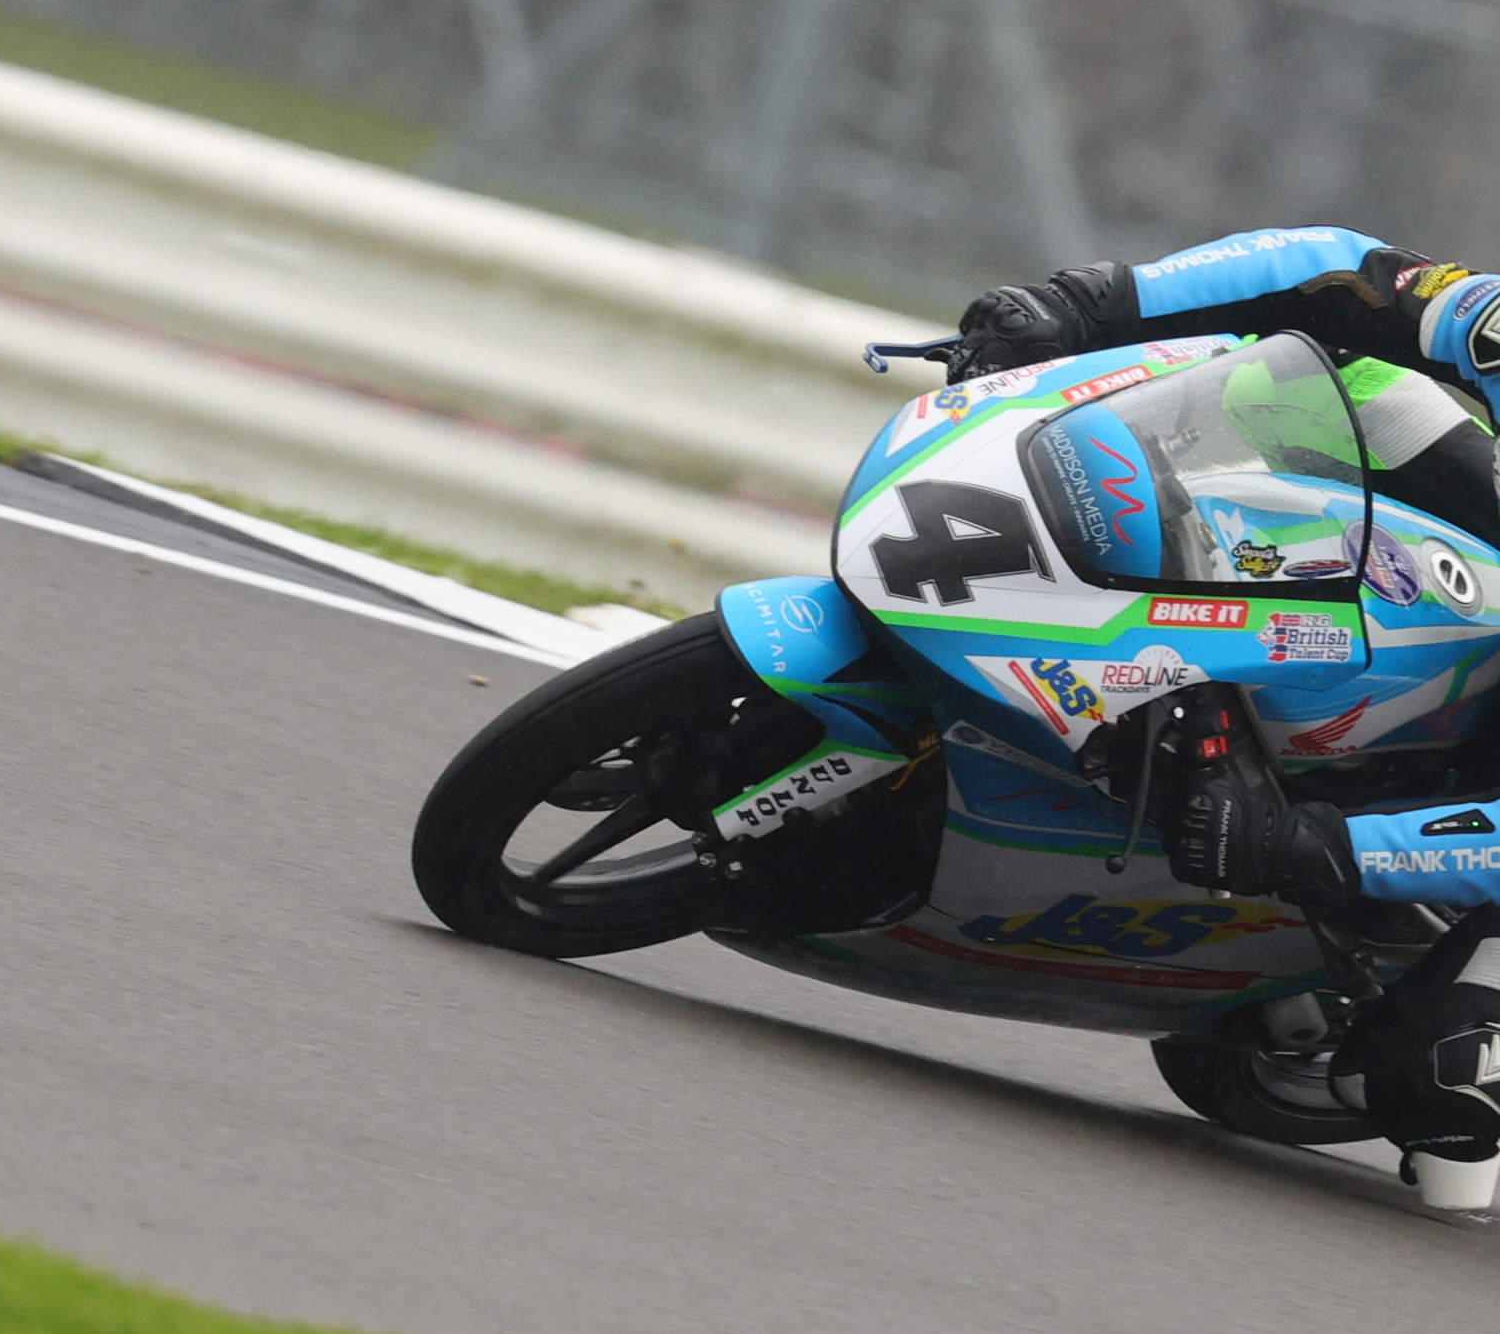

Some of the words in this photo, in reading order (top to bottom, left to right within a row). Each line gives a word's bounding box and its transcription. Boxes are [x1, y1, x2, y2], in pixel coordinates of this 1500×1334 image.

[1249, 230, 1337, 253] FRANK
[1141, 241, 1251, 279] THOMAS
[1090, 367, 1150, 390] BIKE
[1080, 497, 1113, 555] MEDIA
[869, 478, 1056, 607] 4
[1152, 601, 1214, 623] BIKE
[1216, 604, 1244, 624] IT
[1287, 628, 1349, 646] British
[1287, 647, 1326, 660] Talent
[1327, 648, 1350, 662] Cup
[1101, 662, 1189, 687] REDLINE
[736, 757, 853, 828] DUNLOP
[1219, 799, 1232, 834] FRANK
[1360, 845, 1446, 875] FRANK
